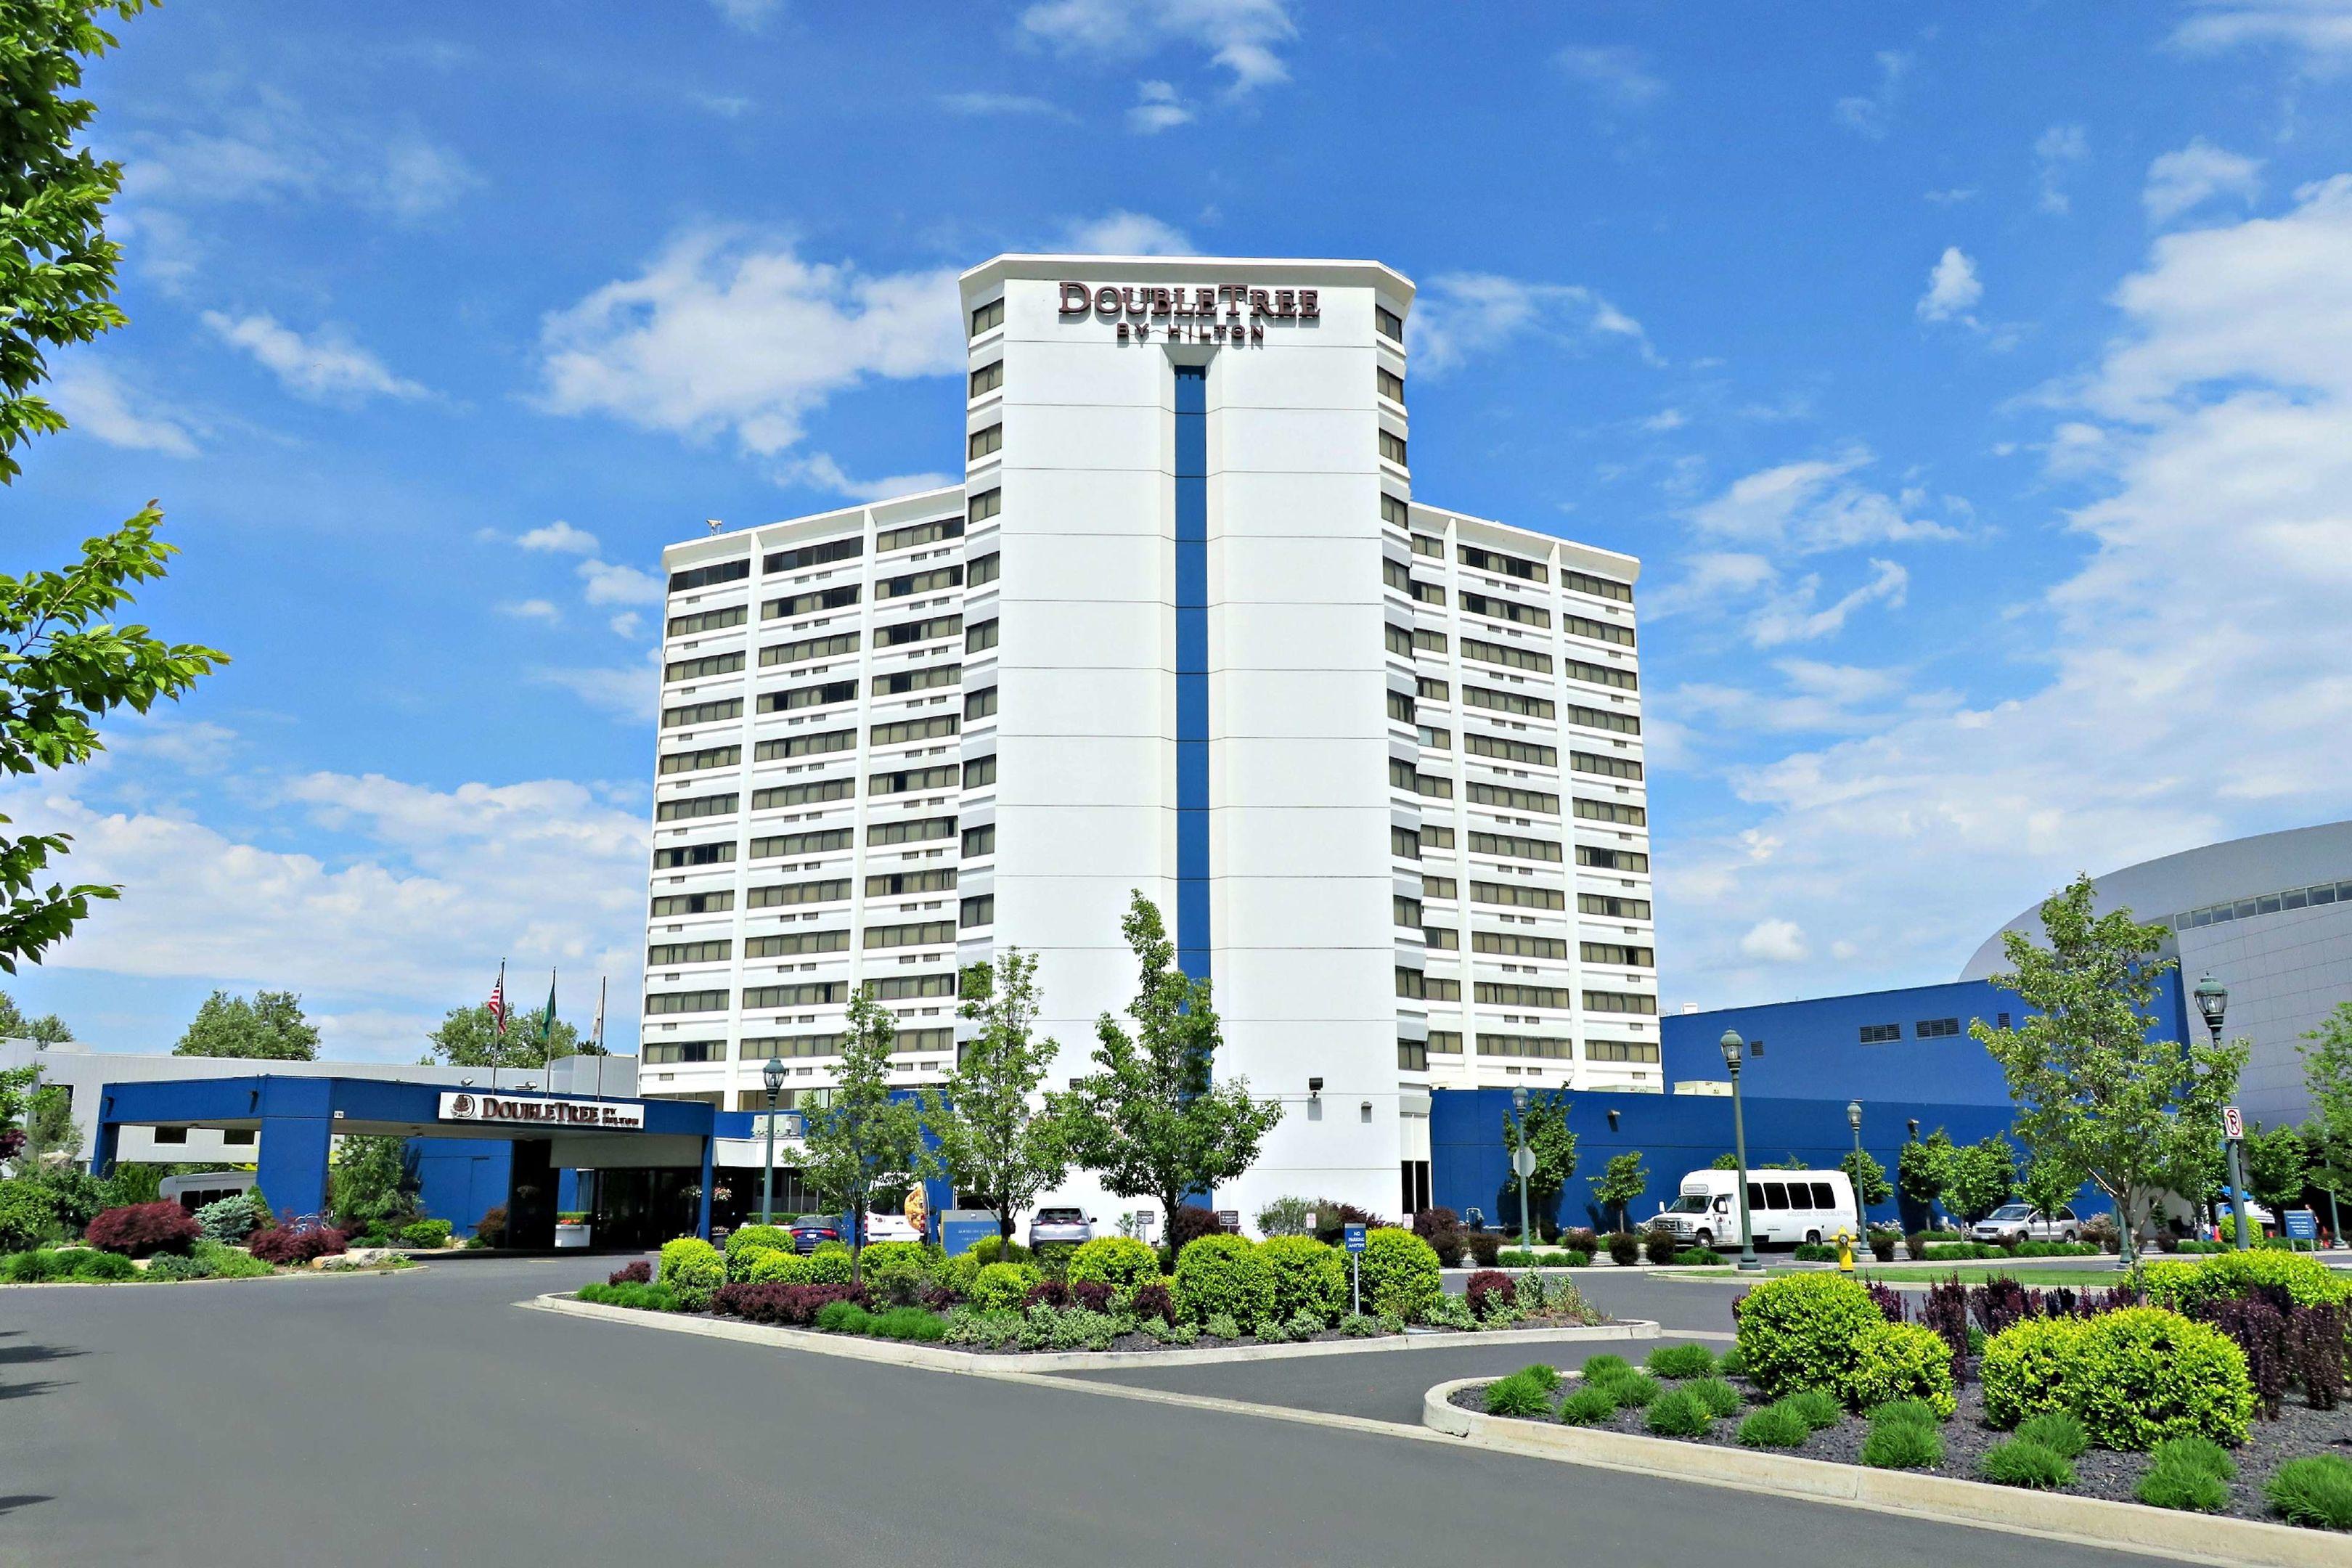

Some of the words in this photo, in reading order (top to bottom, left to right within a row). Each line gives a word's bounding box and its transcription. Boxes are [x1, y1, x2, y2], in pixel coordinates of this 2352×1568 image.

[1058, 282, 1320, 318] DOUBLETREE
[1117, 323, 1149, 337] BY
[1168, 324, 1264, 338] HILTON
[481, 1098, 599, 1123] DOUBLETREE
[602, 1116, 639, 1125] HILTON
